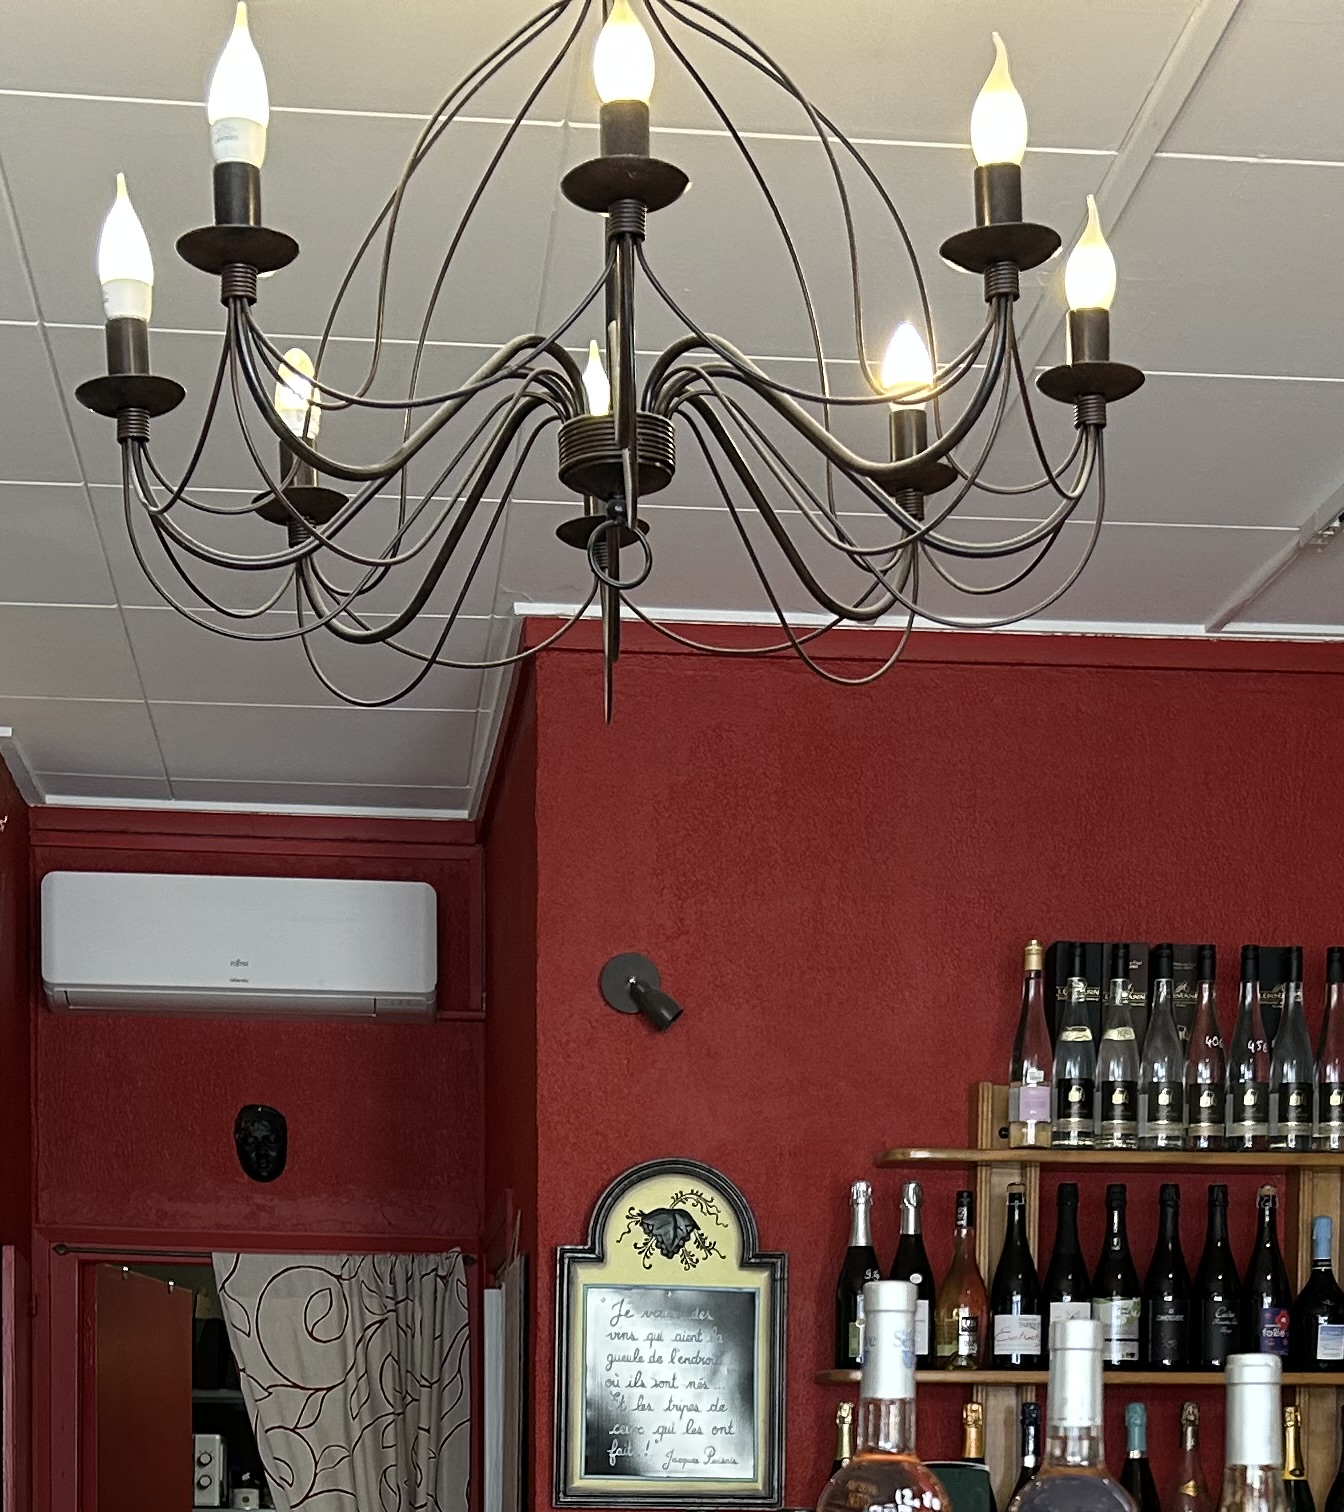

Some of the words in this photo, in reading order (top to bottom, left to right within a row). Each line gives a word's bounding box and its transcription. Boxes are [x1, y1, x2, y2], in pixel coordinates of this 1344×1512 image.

[606, 1330, 638, 1342] vins
[647, 1330, 664, 1348] qui
[606, 1349, 645, 1371] gueule
[648, 1350, 664, 1364] de
[605, 1373, 621, 1389] où
[625, 1372, 646, 1389] ils
[651, 1375, 678, 1389] sont
[635, 1397, 654, 1412] les
[664, 1398, 700, 1419] tripes
[710, 1398, 727, 1412] de
[653, 1421, 676, 1441] qui
[685, 1420, 703, 1435] les
[711, 1422, 735, 1435] ont
